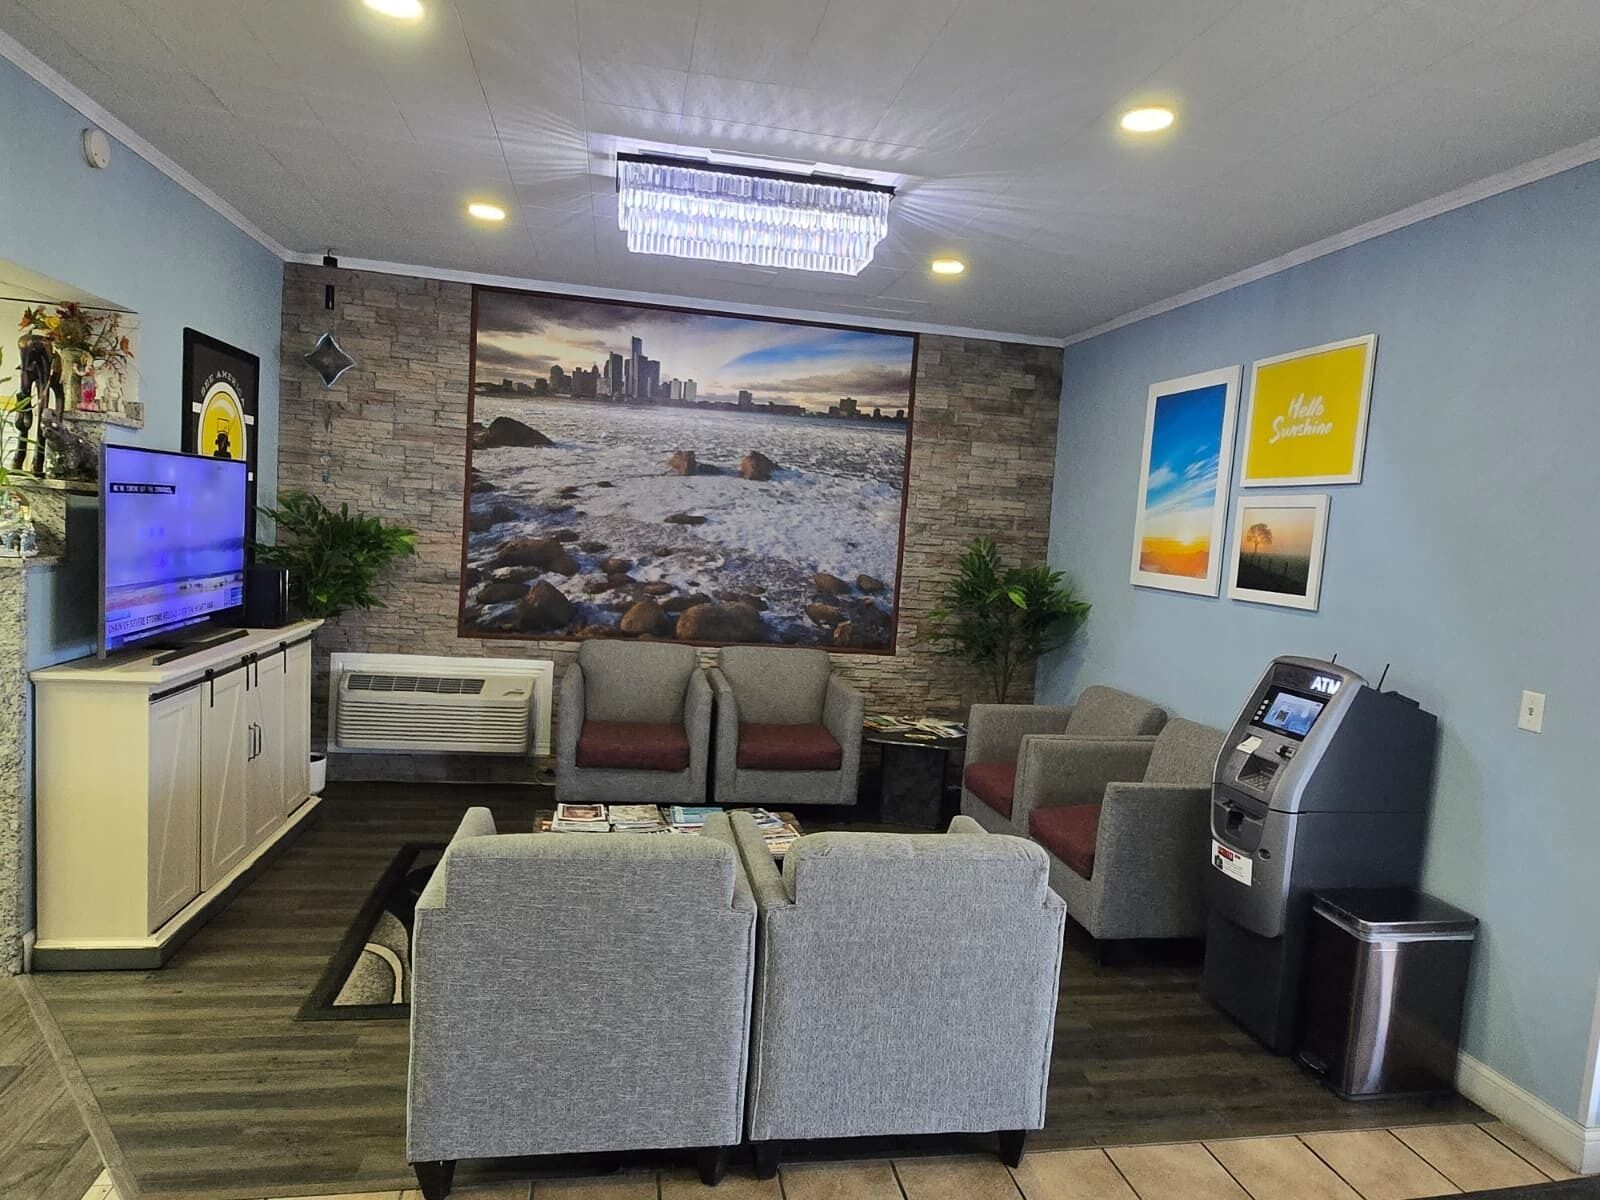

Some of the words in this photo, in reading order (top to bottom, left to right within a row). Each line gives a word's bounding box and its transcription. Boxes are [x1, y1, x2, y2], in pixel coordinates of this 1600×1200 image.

[1288, 392, 1325, 419] Hello
[1269, 415, 1333, 444] Sunshine
[1310, 675, 1342, 695] ATM
